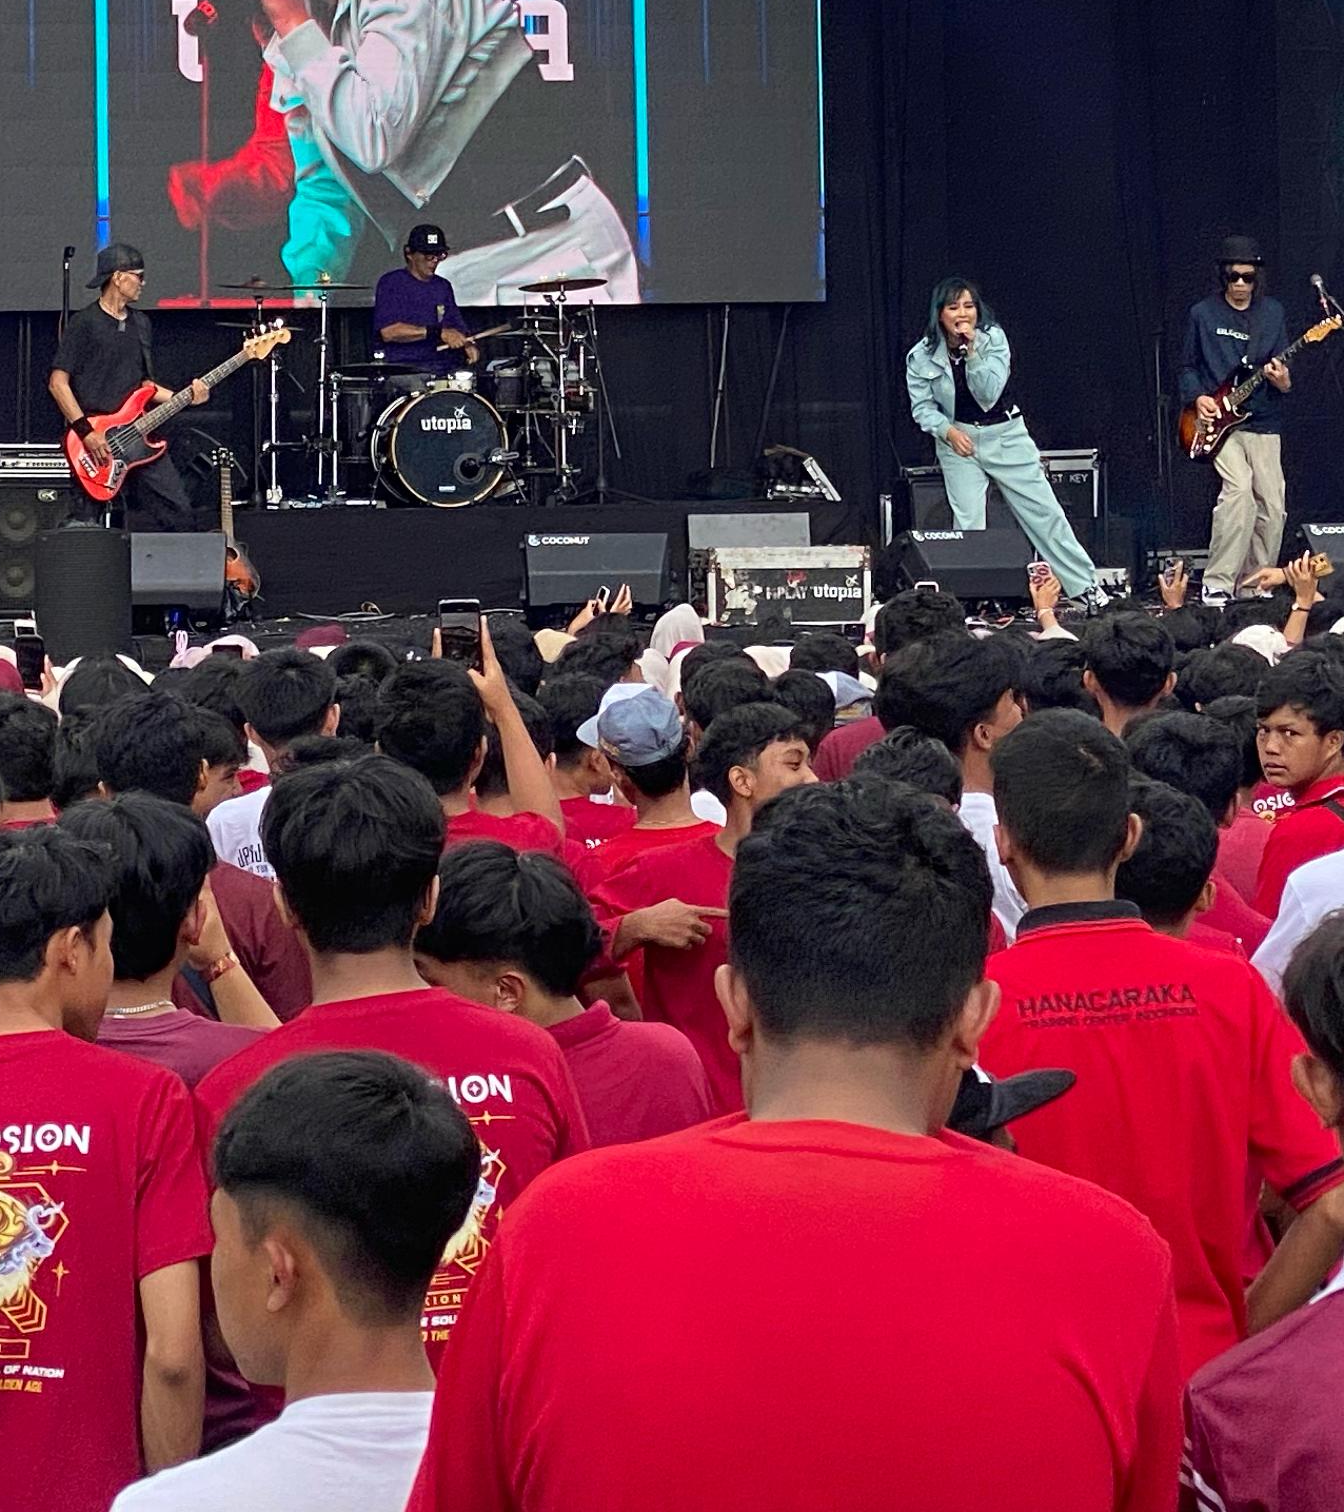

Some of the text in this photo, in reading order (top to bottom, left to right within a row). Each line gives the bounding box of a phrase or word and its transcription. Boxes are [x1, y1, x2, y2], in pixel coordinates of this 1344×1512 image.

[421, 416, 472, 433] utopia
[541, 536, 590, 545] COCONUT
[1017, 983, 1196, 1018] HANACARAKA
